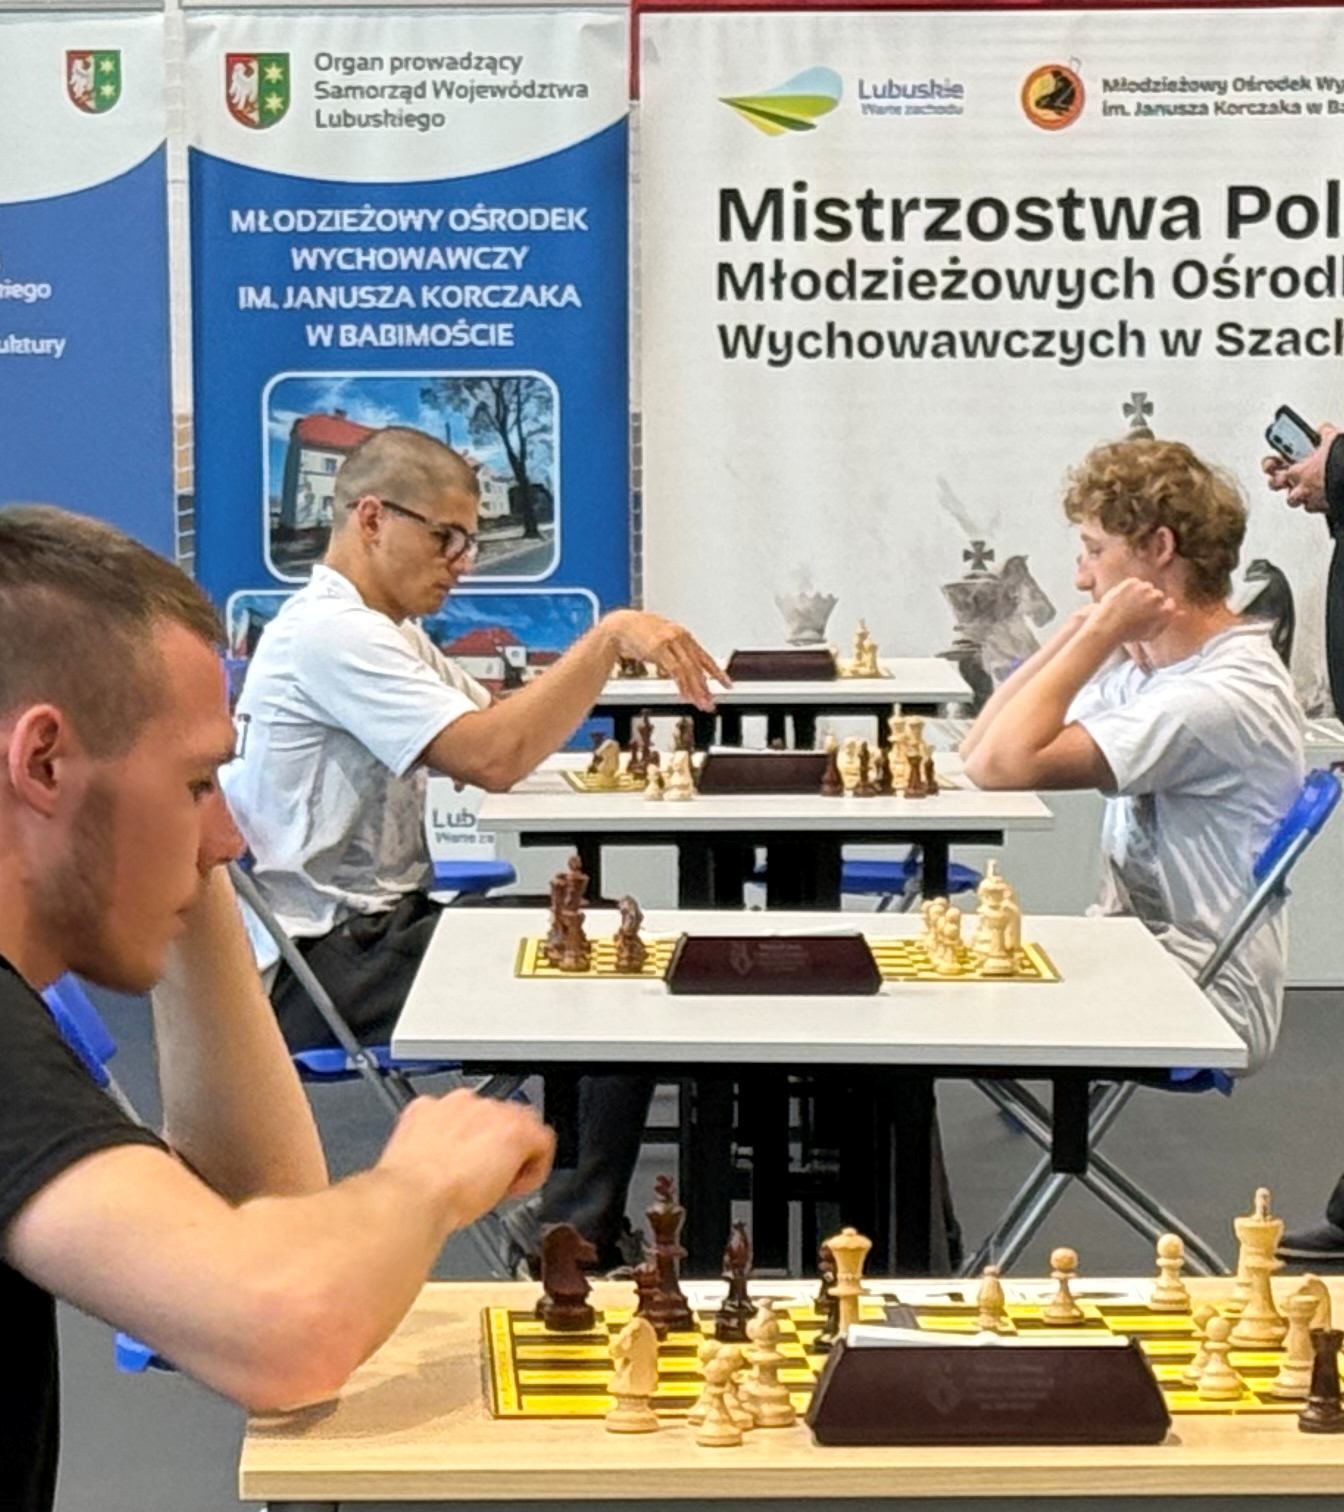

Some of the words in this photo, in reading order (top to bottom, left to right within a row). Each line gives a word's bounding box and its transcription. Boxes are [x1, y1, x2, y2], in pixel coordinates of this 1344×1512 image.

[313, 51, 385, 77] Organ
[389, 51, 524, 76] prowadzący
[313, 79, 427, 105] Samorząd
[431, 79, 589, 104] Województwa
[858, 77, 965, 100] Lubuskie
[1101, 75, 1229, 96] Młodzieżowy
[1231, 74, 1313, 93] Ośrodek
[315, 108, 446, 133] Lubuskiego
[1133, 101, 1210, 117] Janusza
[1213, 98, 1303, 117] Korczaka
[1305, 102, 1324, 116] w
[230, 203, 443, 233] MŁODZIEŻOWY
[448, 202, 589, 232] OŚRODEK
[718, 179, 1202, 243] Mistrzostwa
[290, 245, 530, 271] WYCHOWAWCZY
[717, 255, 1155, 310] Młodzieżowych
[238, 285, 279, 310] IM.
[282, 284, 417, 310] JANUSZA
[421, 283, 583, 309] KORCZAKA
[305, 323, 335, 348] W
[339, 321, 515, 348] BABIMOŚCIE
[717, 319, 1146, 368] Wychowawczych
[1159, 328, 1203, 358] w
